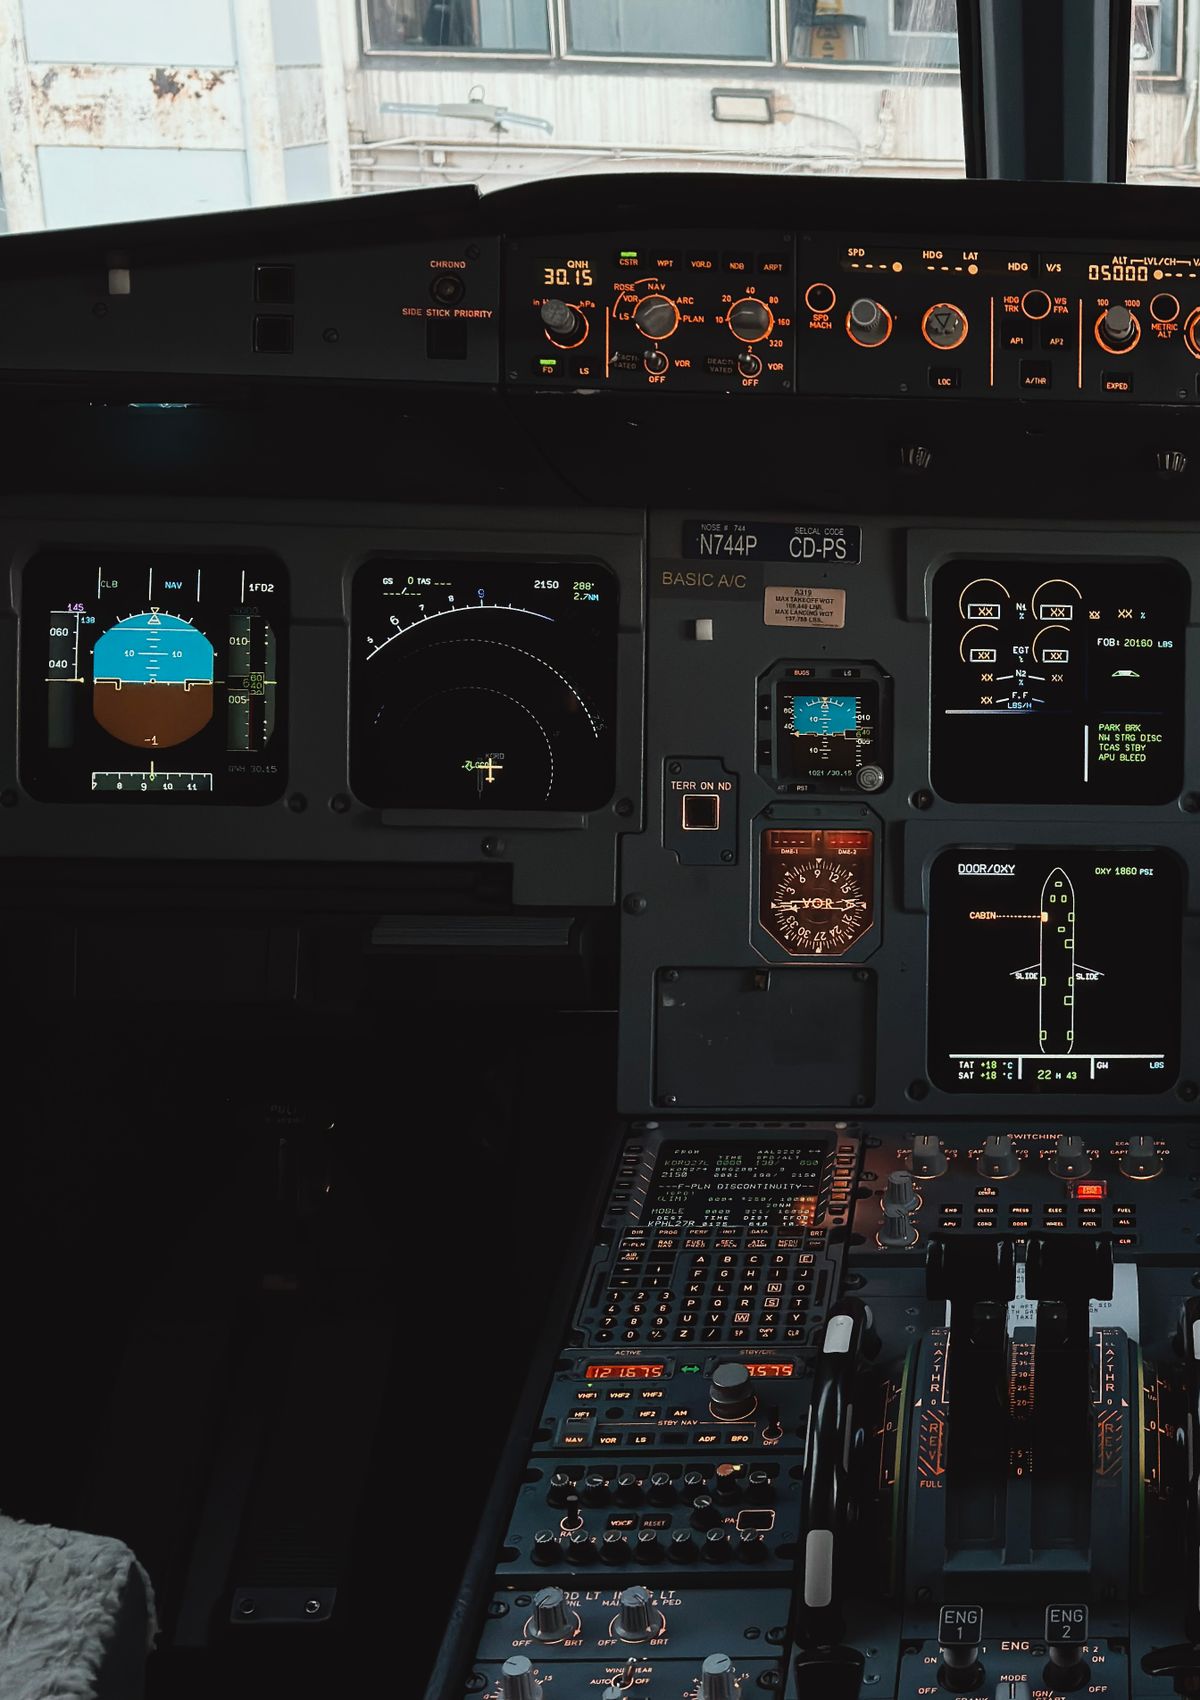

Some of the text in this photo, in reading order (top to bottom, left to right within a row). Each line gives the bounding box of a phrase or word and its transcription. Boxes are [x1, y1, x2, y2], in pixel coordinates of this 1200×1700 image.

[847, 248, 865, 257] SPD
[922, 250, 944, 260] HDG
[962, 251, 979, 261] LAT
[430, 260, 466, 269] CHRONO
[566, 260, 589, 269] QNH
[619, 258, 639, 266] CSTR
[656, 259, 673, 267] WPT
[1111, 255, 1128, 265] ALT
[1007, 262, 1029, 272] HDG
[544, 268, 593, 286] 30.15
[1088, 264, 1148, 282] 05000
[613, 283, 635, 292] ROSE
[647, 283, 666, 291] NAV
[676, 296, 694, 305] ARC
[401, 307, 493, 318] SIDE STICK PRIORITY
[682, 314, 705, 323] PLAN
[1151, 322, 1178, 331] METRIC
[1157, 330, 1172, 339] ALT
[769, 339, 784, 348] 320
[1009, 336, 1024, 345] AP1
[674, 359, 691, 368] VOR
[648, 375, 666, 384] OFF
[1106, 381, 1129, 391] EXPED
[700, 523, 746, 532] NOSE 744
[794, 526, 845, 536] SELCAL CODE
[701, 534, 757, 555] N744P
[790, 537, 846, 559] CD-PS
[100, 580, 118, 588] CLB
[382, 577, 432, 586] GS TAS
[533, 579, 560, 589] 2150
[662, 571, 747, 589] BASIC A/C
[164, 581, 183, 590] NAV
[248, 583, 275, 593] 1FD2
[1015, 602, 1027, 611] N1
[49, 627, 69, 637] 060
[1097, 637, 1174, 648] FOB: 20160 LBS
[1012, 645, 1030, 655] EGT
[48, 659, 68, 669] 040
[1007, 701, 1032, 710] LBS/H
[1098, 723, 1142, 732] PARK BRK
[1098, 733, 1163, 743] NW STRG DISC
[1099, 742, 1147, 752] TCAS STBY
[1098, 752, 1147, 762] APU BLEED
[671, 780, 732, 791] TERR ON ND
[957, 863, 1016, 876] DOOR/OXY
[1094, 866, 1154, 876] OXY 1860 PSI
[802, 898, 832, 909] VOR
[959, 1060, 997, 1070] TAT +18
[1096, 1061, 1109, 1070] GW
[1149, 1061, 1165, 1069] LBS
[1037, 1069, 1052, 1080] 22
[919, 1479, 943, 1489] FULL
[944, 1610, 978, 1624] ENG
[1050, 1609, 1084, 1623] ENG
[957, 1626, 963, 1640] 1
[1062, 1624, 1071, 1639] 2
[597, 1639, 618, 1647] OFF
[649, 1638, 669, 1646] BRT
[1001, 1641, 1030, 1651] ENG
[1000, 1674, 1027, 1682] MODE
[1088, 1685, 1108, 1693] OFF
